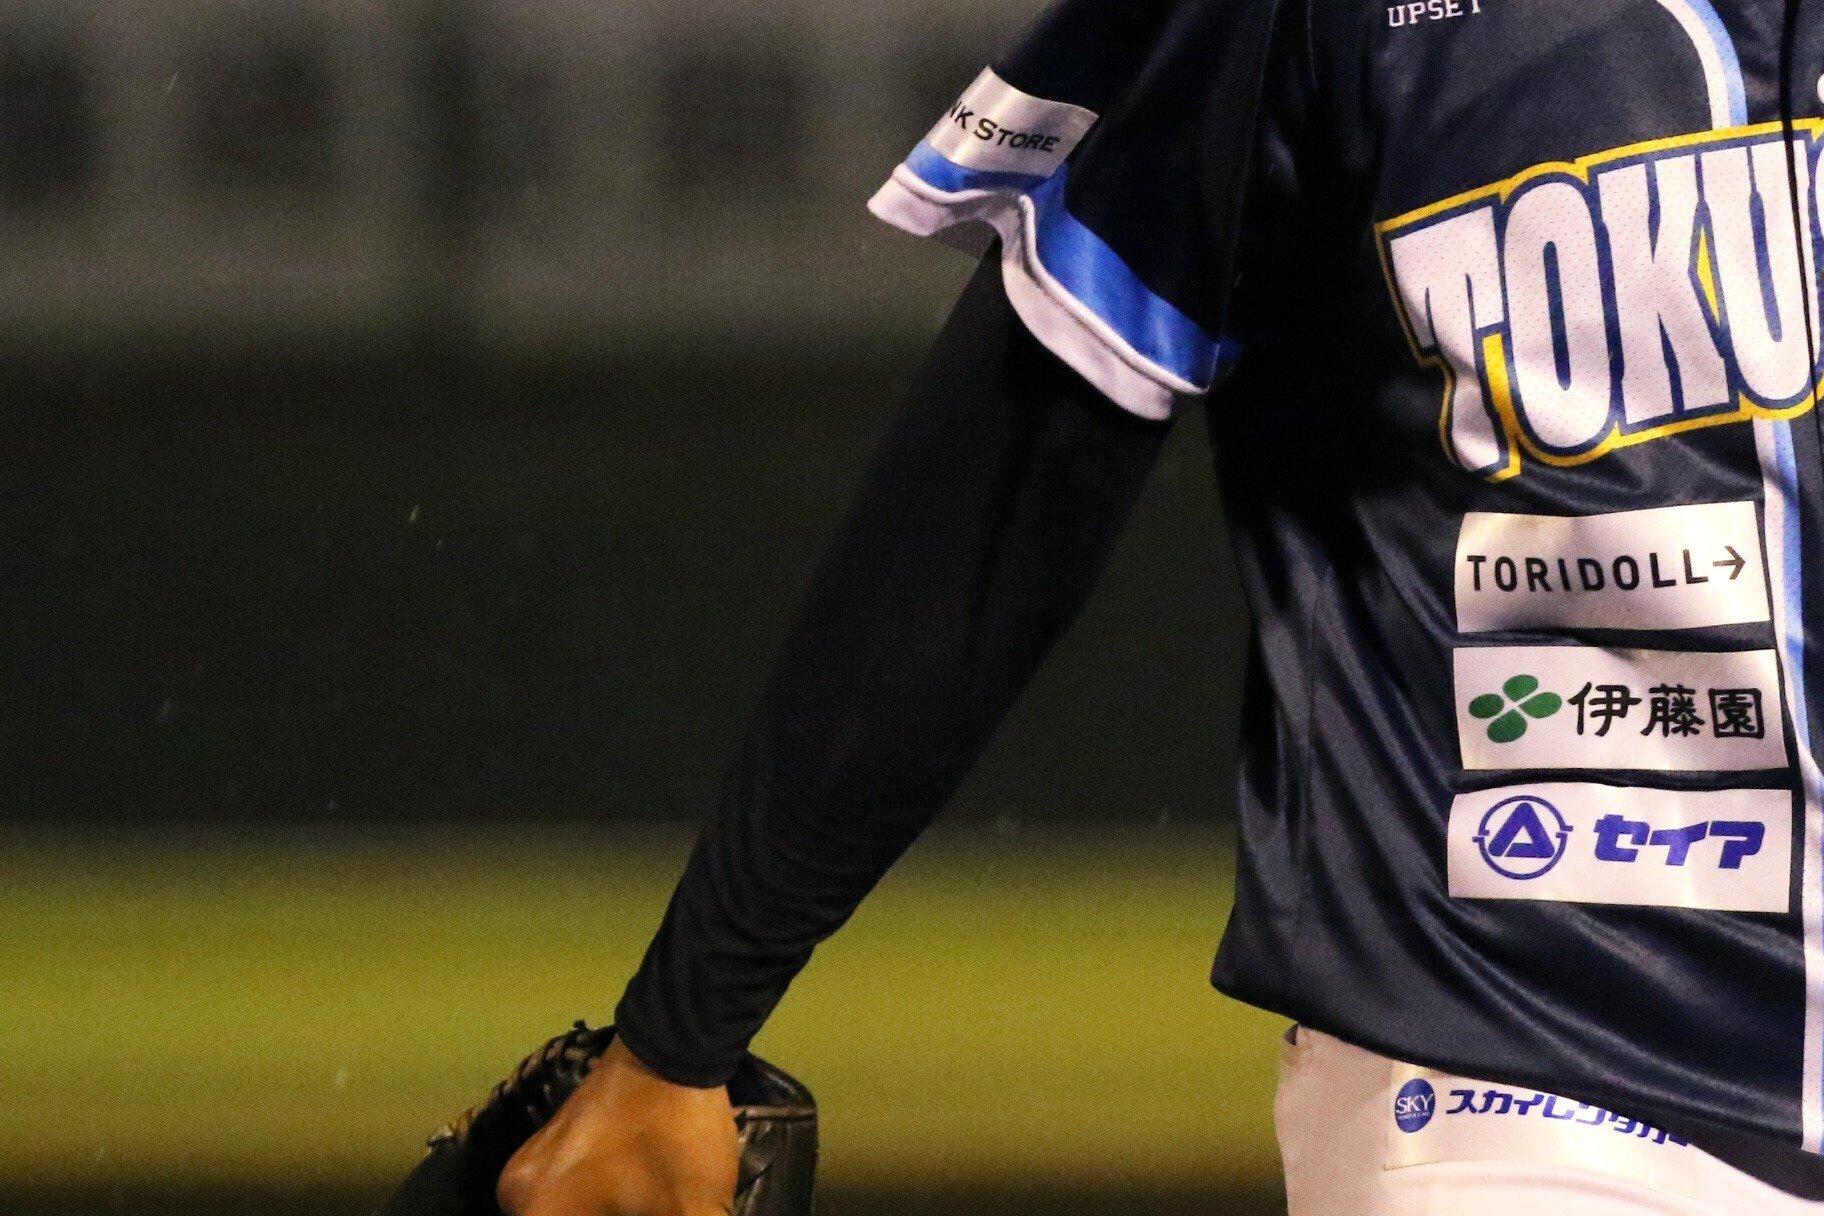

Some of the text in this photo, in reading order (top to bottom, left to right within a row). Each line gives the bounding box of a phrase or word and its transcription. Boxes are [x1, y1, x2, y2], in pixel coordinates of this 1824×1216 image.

[1466, 549, 1709, 592] TORIDOLL
[1567, 681, 1765, 740] 伊藤園
[1593, 813, 1766, 870] セイア
[1396, 1093, 1434, 1114] SKY
